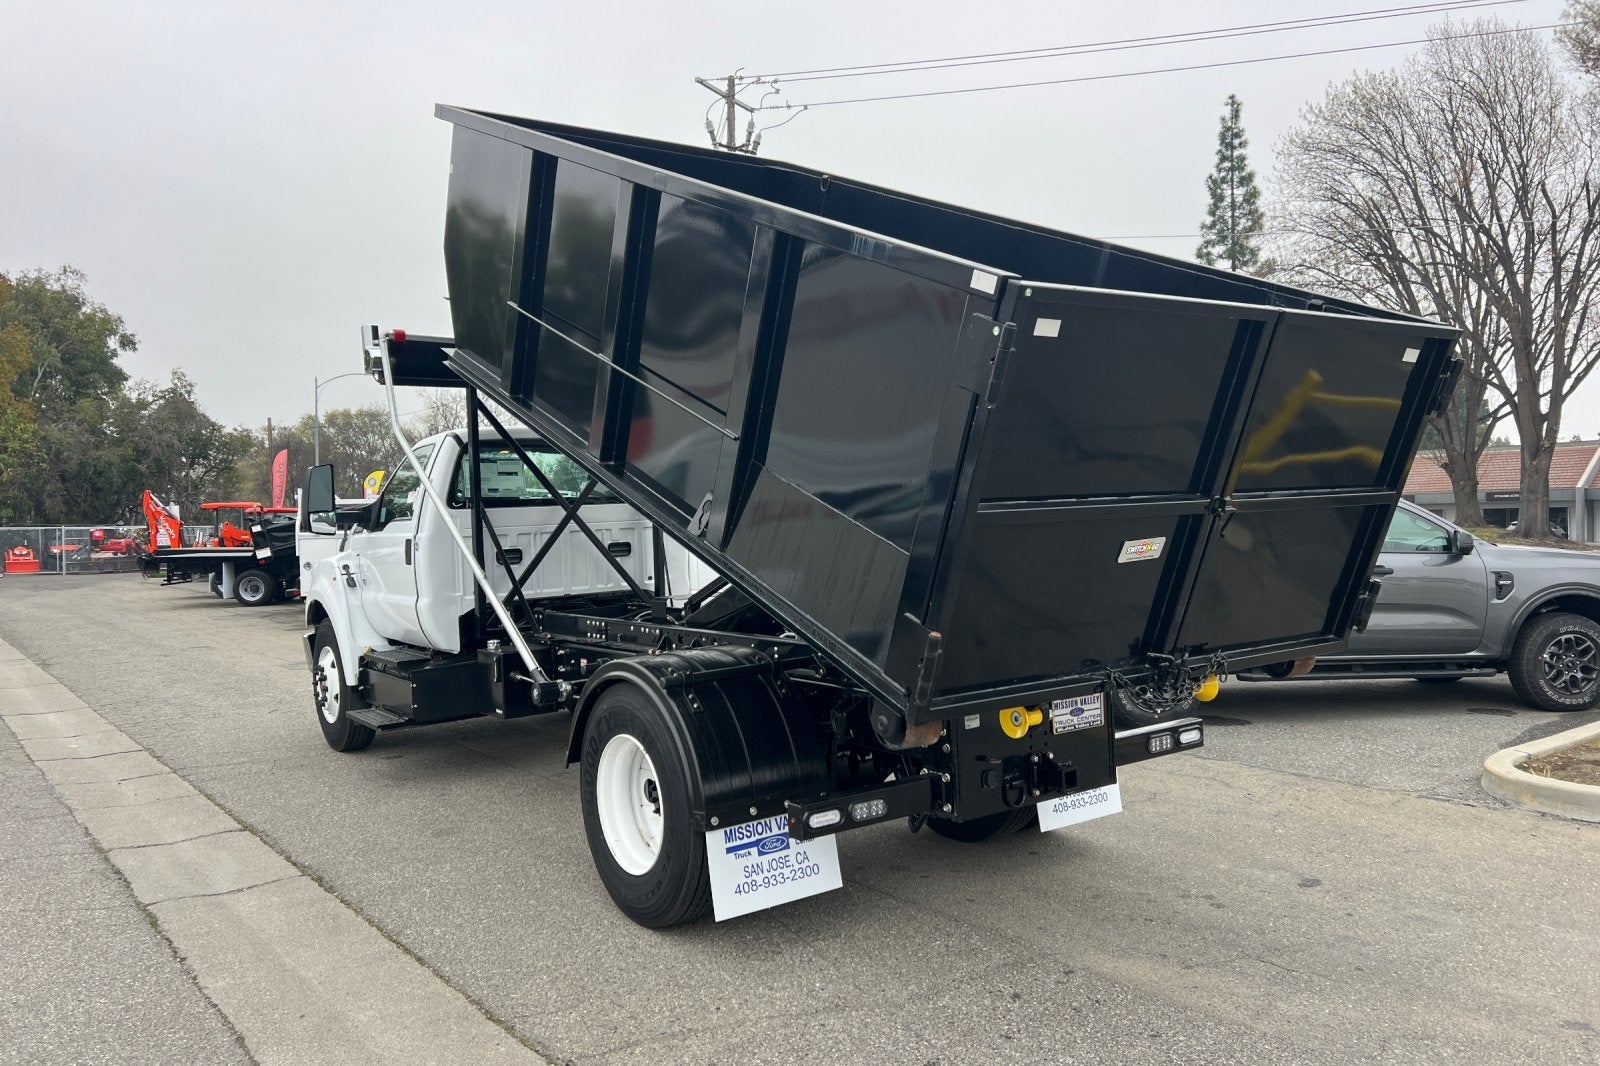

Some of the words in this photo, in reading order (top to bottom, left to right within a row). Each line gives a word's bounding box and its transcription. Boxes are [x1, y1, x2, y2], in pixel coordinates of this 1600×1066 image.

[1054, 699, 1079, 710] MISSION
[1079, 695, 1100, 706] VALLEY
[1055, 718, 1075, 727] TRUCK
[1077, 713, 1101, 722] CENTER
[1052, 792, 1108, 814] 408-933-2300
[724, 819, 772, 844] MISSION
[764, 839, 782, 849] Ford
[734, 850, 752, 860] Truck
[743, 861, 764, 879] SAN
[767, 854, 794, 873] JOSE,
[795, 850, 810, 865] CA
[734, 863, 820, 895] 408-933-2300
